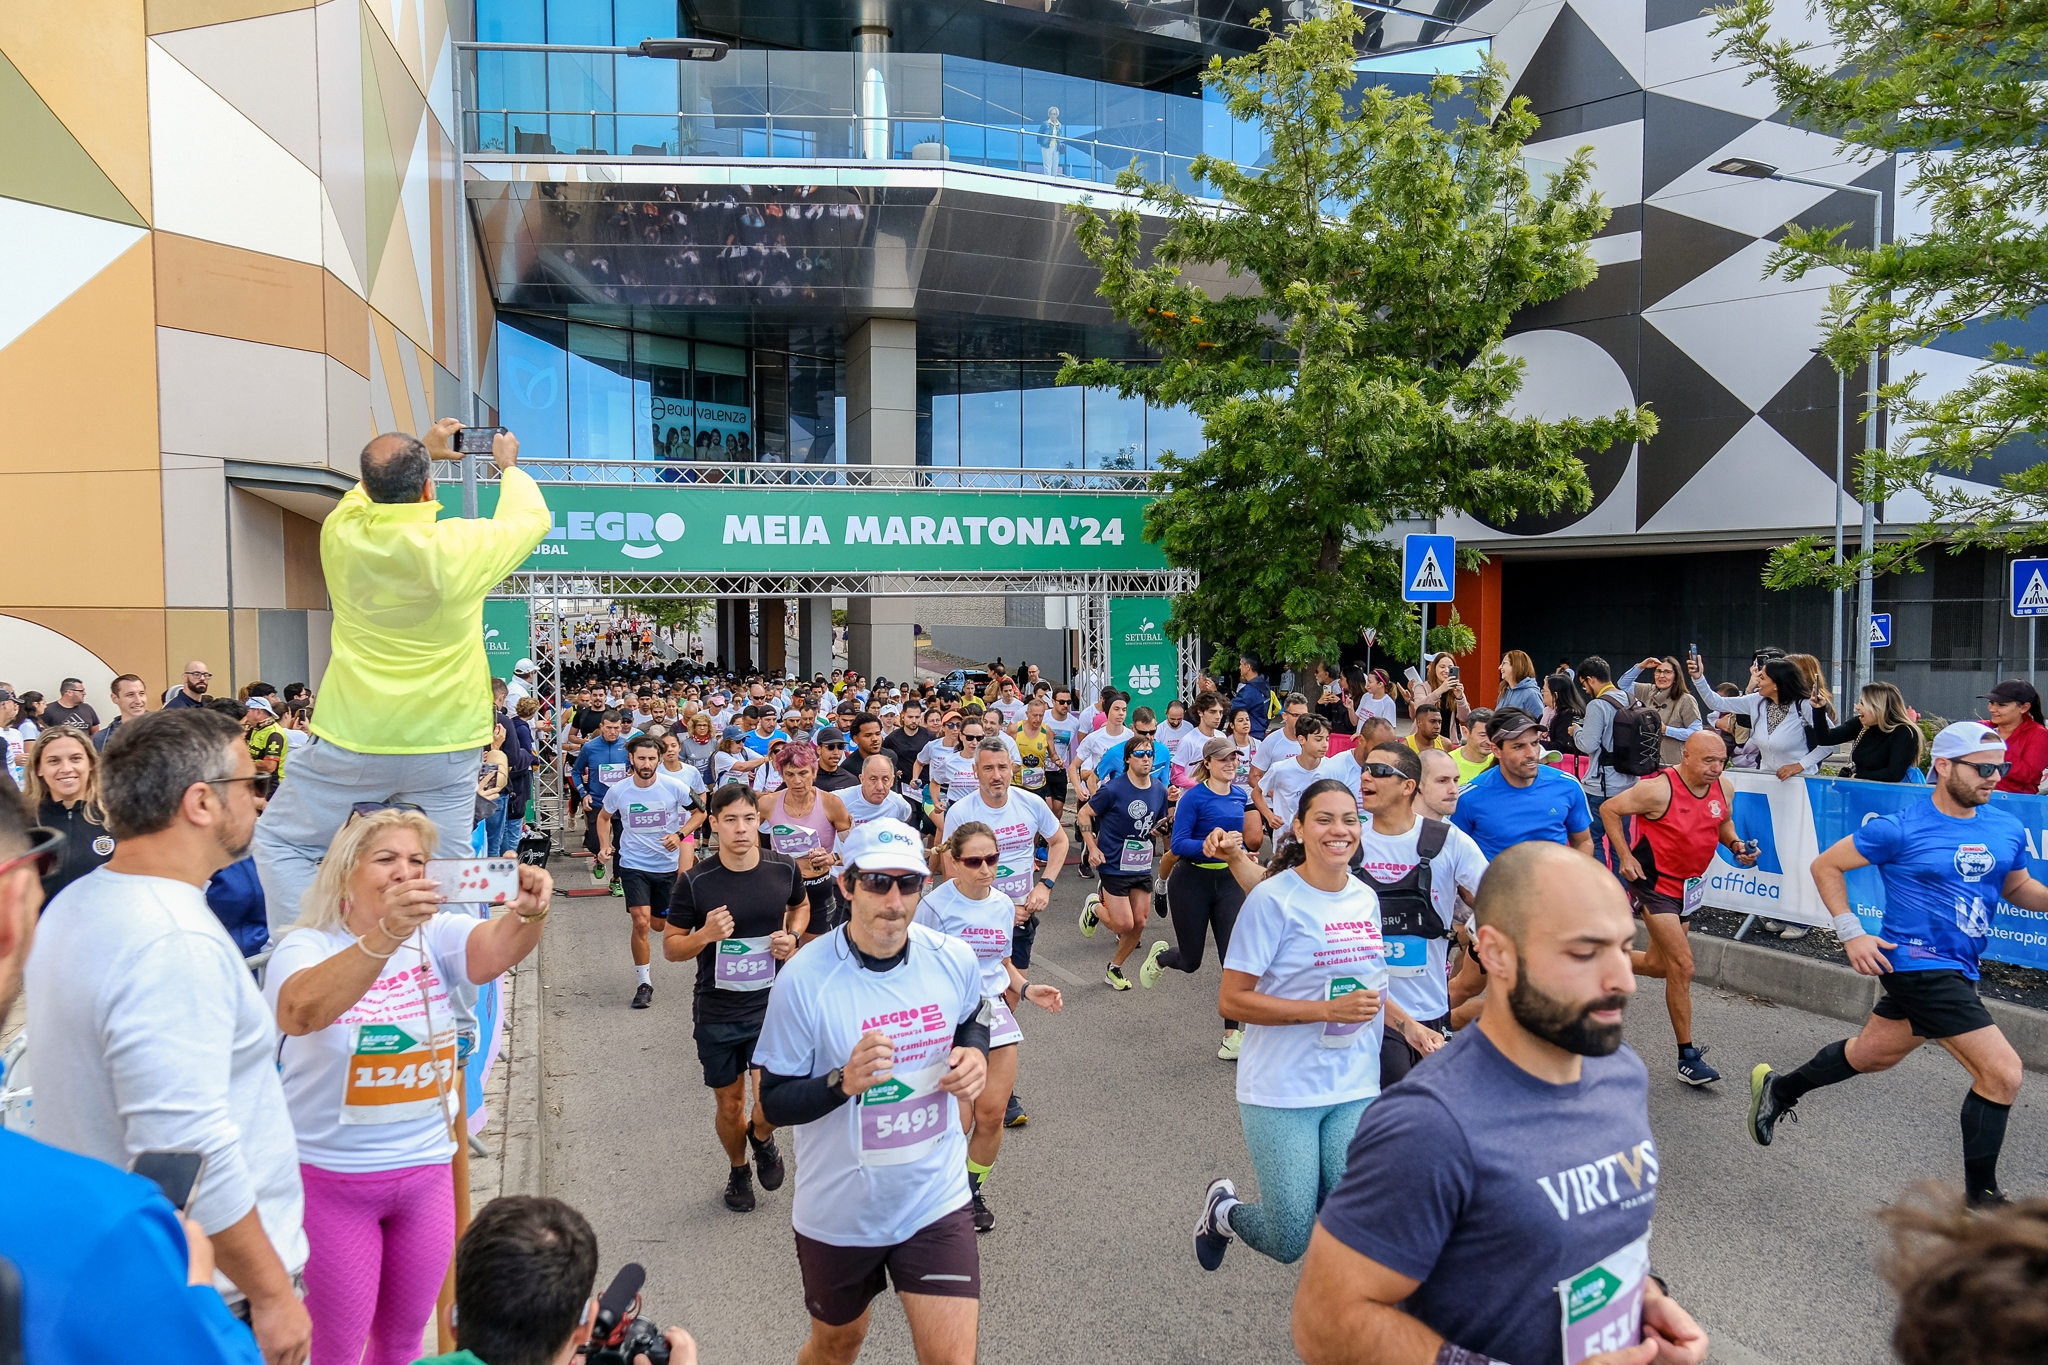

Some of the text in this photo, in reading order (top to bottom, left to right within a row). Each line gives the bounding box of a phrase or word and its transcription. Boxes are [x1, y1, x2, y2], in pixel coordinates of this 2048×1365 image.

[543, 511, 685, 542] LEGRO
[722, 514, 831, 544] MEIA
[635, 813, 661, 825] 5556
[780, 836, 813, 849] 5224
[894, 833, 913, 846] edp
[1127, 853, 1150, 862] 5477
[1364, 862, 1408, 872] ALEGRO
[997, 879, 1027, 893] 5055
[1711, 872, 1780, 899] affidea
[1857, 903, 1884, 919] Enfe
[961, 928, 995, 936] ALEGRO
[1324, 921, 1363, 932] ALEGRO
[1313, 947, 1351, 958] corremos
[726, 958, 768, 976] 5632
[1314, 959, 1325, 967] da
[1327, 957, 1353, 966] cidade
[861, 1008, 919, 1031] ALEGRO
[901, 1050, 926, 1063] serra!
[876, 1103, 939, 1139] 5493
